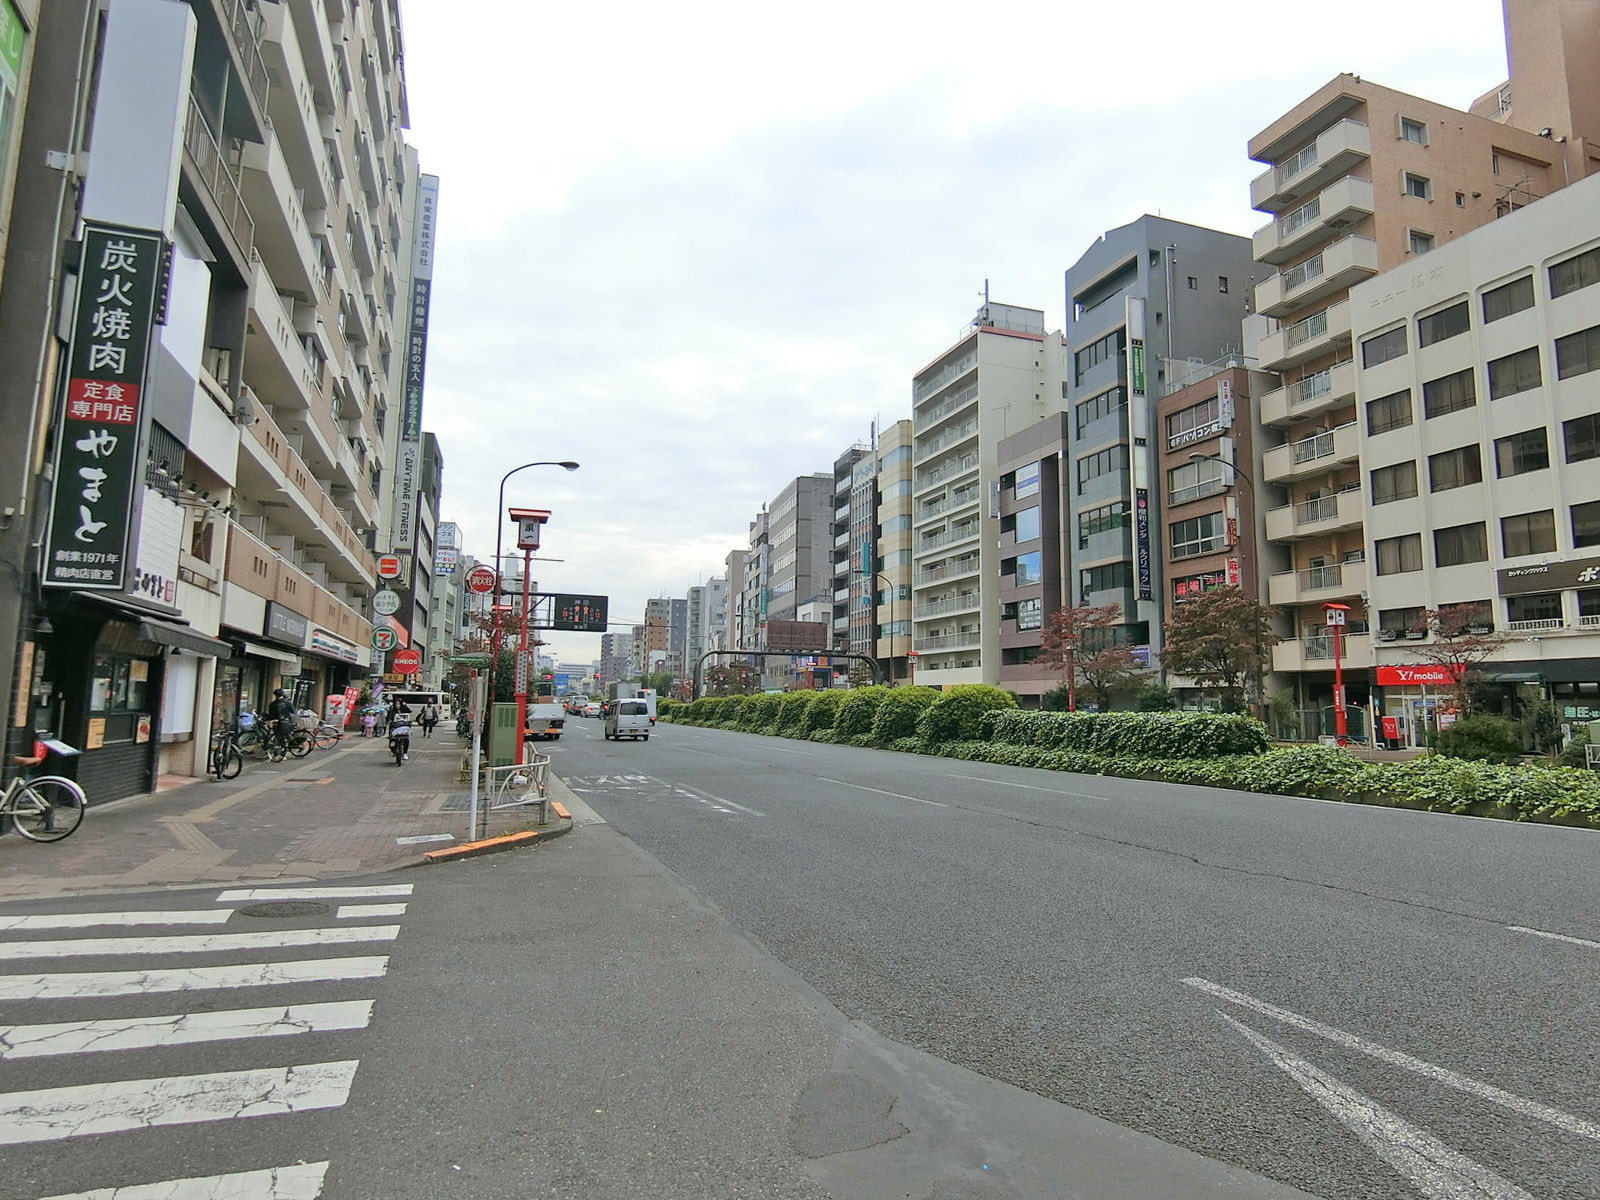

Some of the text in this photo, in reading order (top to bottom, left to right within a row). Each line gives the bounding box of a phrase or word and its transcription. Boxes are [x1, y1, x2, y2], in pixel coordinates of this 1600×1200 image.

[88, 240, 138, 375] 炭火焼肉
[83, 381, 125, 402] 定食
[71, 400, 135, 422] 専門店
[75, 429, 119, 543] やまと
[400, 458, 413, 542] ANYTIME FITNESS
[55, 550, 119, 565] 創業1971年
[54, 566, 115, 581] 精肉店直営
[471, 575, 494, 587] 消火栓
[1508, 566, 1548, 577] カッティングハウス
